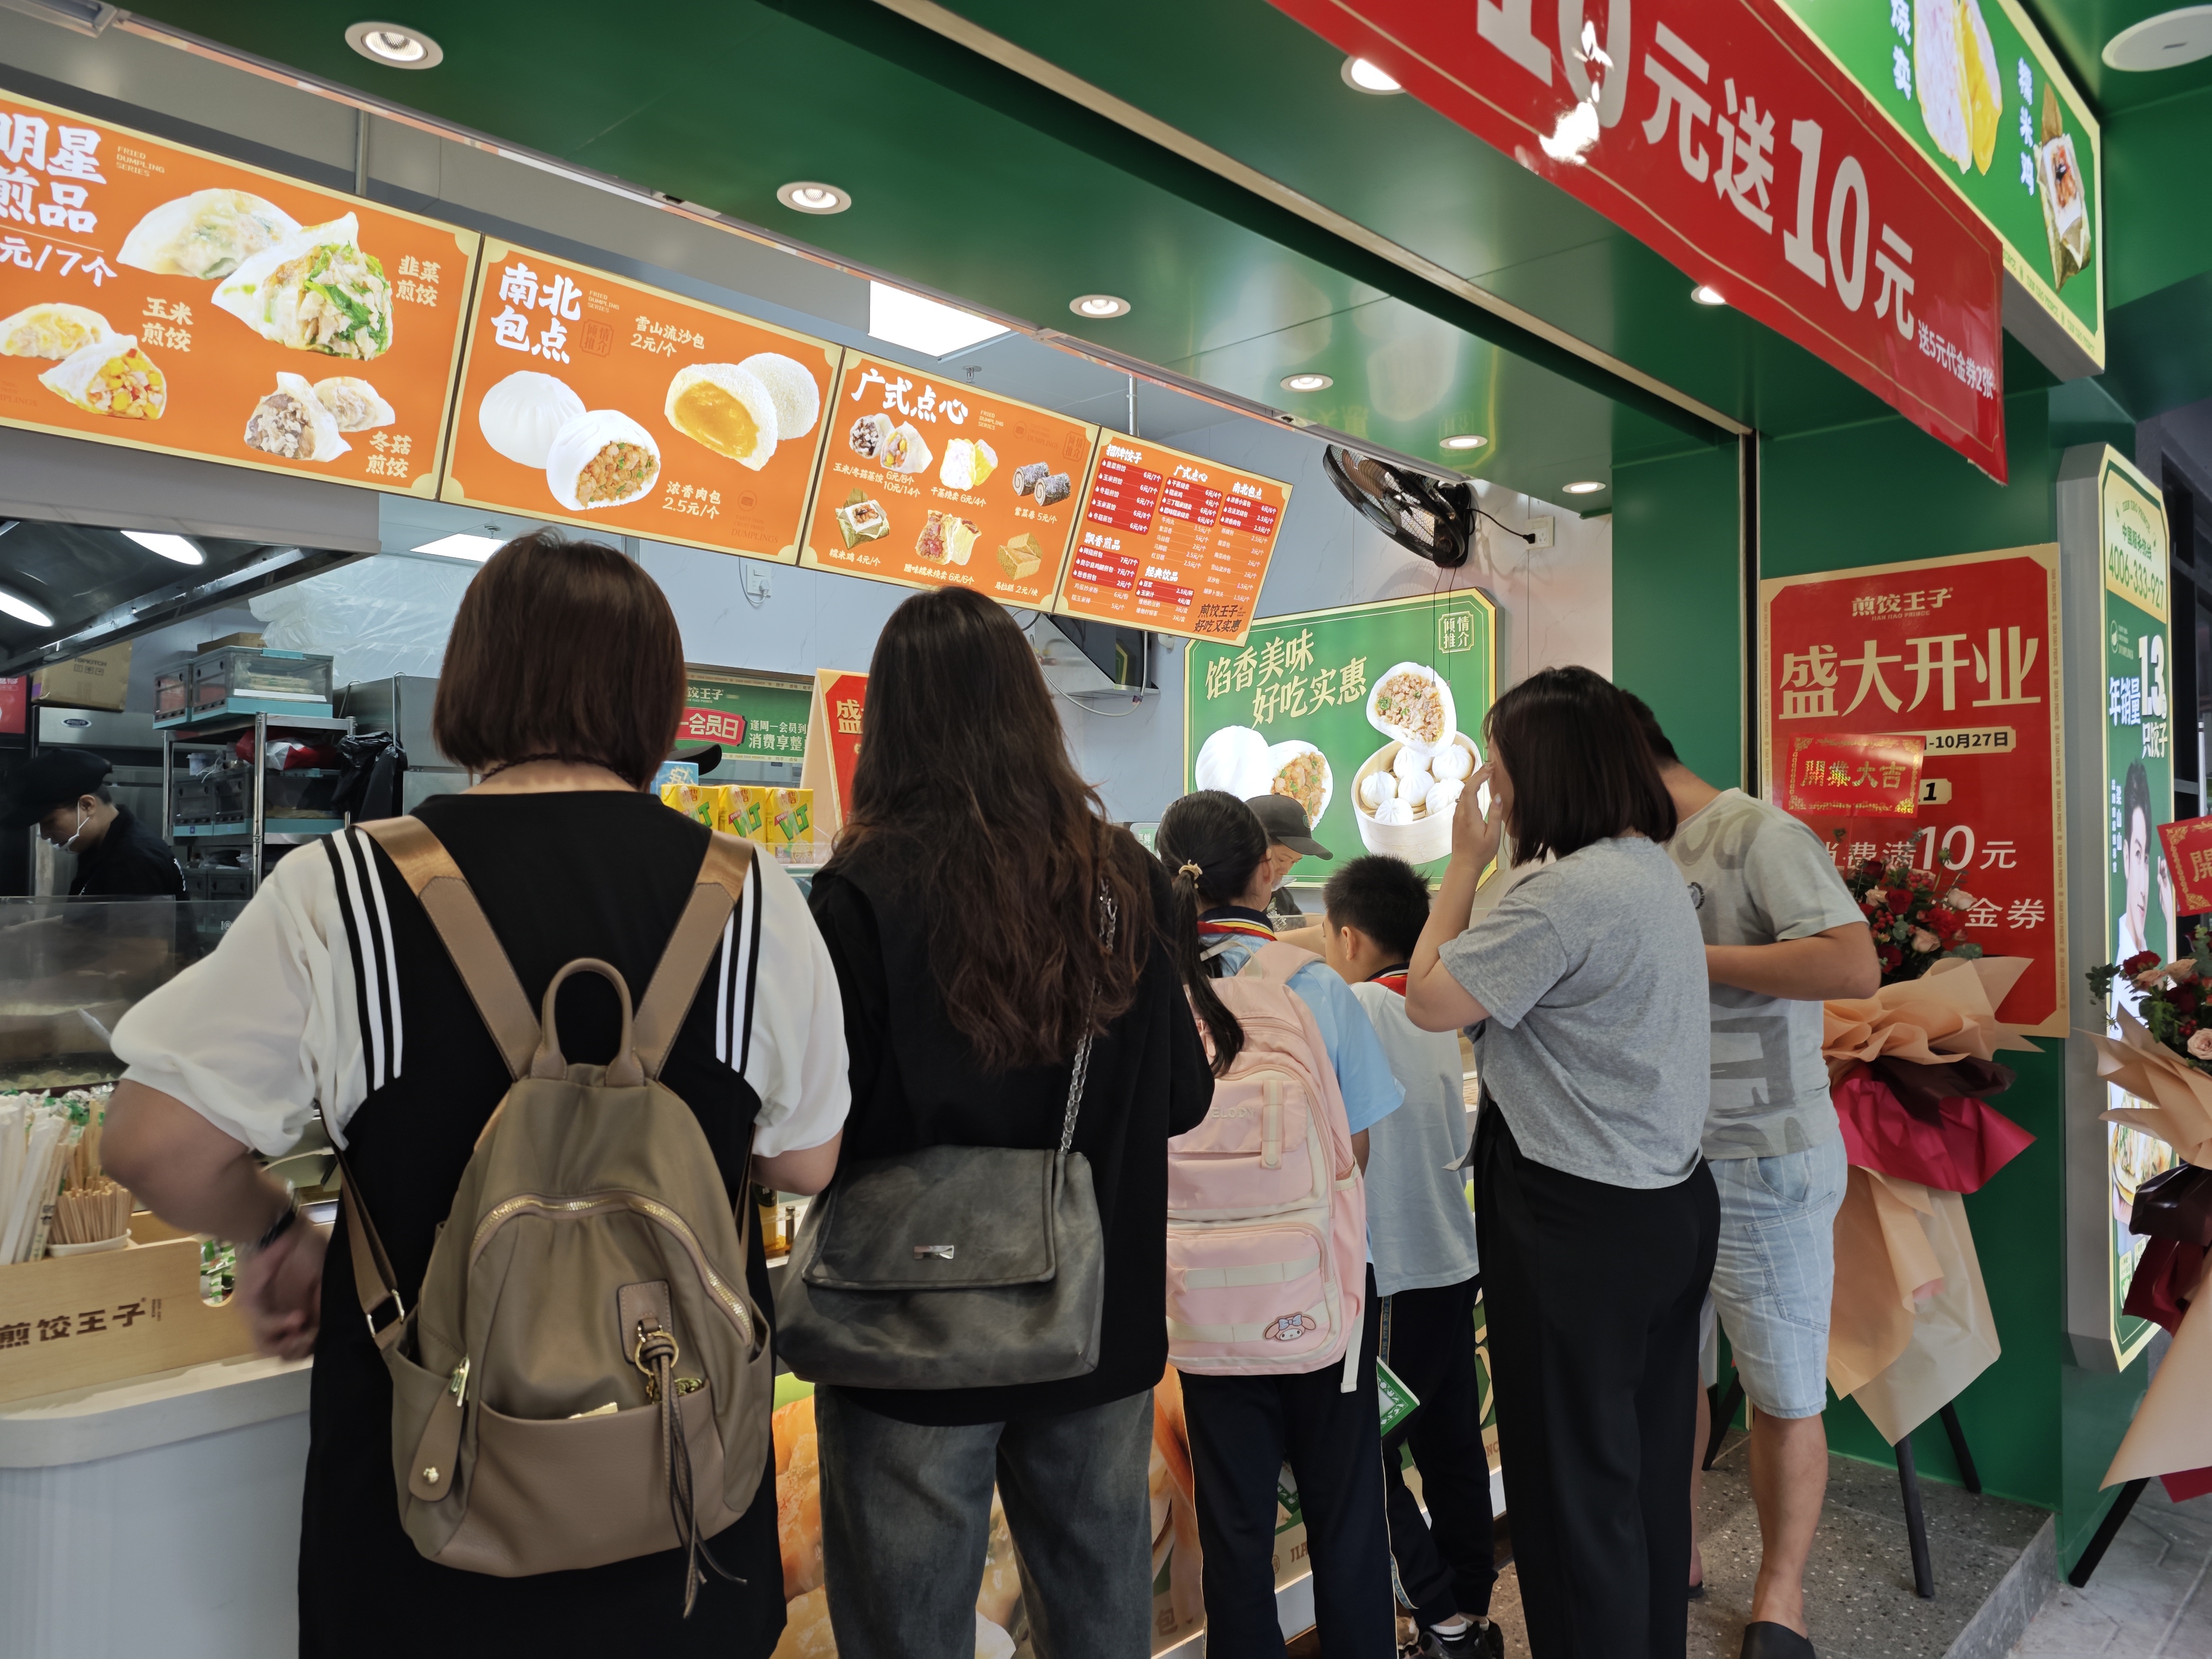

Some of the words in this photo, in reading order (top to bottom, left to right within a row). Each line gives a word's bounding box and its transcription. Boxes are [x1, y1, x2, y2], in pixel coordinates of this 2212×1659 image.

[0, 113, 107, 185] 明星
[117, 146, 146, 160] FRIED
[116, 154, 165, 174] DUMPLING
[116, 162, 150, 177] SERIES
[398, 255, 441, 284] 韭菜
[395, 279, 439, 307] 煎饺
[498, 262, 583, 321] 南北
[589, 290, 608, 300] FRIED
[142, 296, 194, 325] 玉米
[587, 302, 610, 313] SERIES
[588, 296, 619, 311] DUMPLING
[141, 322, 192, 352] 煎饺
[491, 305, 570, 364] 包点
[586, 322, 613, 341] 倾情
[635, 315, 705, 349] 雪山流沙包
[584, 336, 608, 353] 推介
[630, 333, 677, 358] 2元/个
[1918, 319, 1993, 400] 送5元代金券2张
[851, 368, 968, 425] 广式点心
[980, 410, 995, 419] FRIED
[978, 421, 996, 430] SERIES
[369, 430, 412, 455] 冬菇
[1106, 443, 1142, 464] 招牌饺子
[366, 454, 409, 478] 煎饺
[833, 462, 884, 484] 玉米/冬菇蒸饺
[886, 470, 914, 485] 6元/8个
[1173, 464, 1208, 482] 广式点心
[1143, 471, 1162, 482] 6元/7个
[666, 481, 721, 504] 浓香肉包
[884, 481, 921, 498] 10元/14个
[930, 487, 959, 502] 干蒸烧卖
[960, 494, 987, 508] 6元/4个
[1139, 484, 1158, 495] 6元/7个
[1205, 489, 1222, 500] 6元/4个
[1232, 481, 1263, 501] 南北包点
[662, 497, 720, 520] 2.5元/个
[1136, 497, 1155, 508] 6元/7个
[1205, 499, 1219, 508] 4元/个
[1260, 505, 1277, 515] 6元/6个
[1037, 512, 1057, 524] 5元/个
[1133, 510, 1151, 521] 6元/8个
[1197, 516, 1215, 527] 6元/6个
[1200, 507, 1217, 518] 6元/6个
[1256, 515, 1274, 525] 2.5元/个
[731, 528, 779, 544] DUMPLINGS
[1129, 522, 1148, 533] 6元/8个
[1253, 524, 1271, 535] 2.5元/个
[1192, 543, 1206, 552] 2元/个
[1195, 535, 1209, 543] 5元/个
[829, 548, 855, 562] 糯米鸡
[856, 555, 881, 567] 4元/个
[1120, 557, 1138, 567] 7元/7个
[1183, 559, 1202, 570] 2.5元/个
[903, 563, 948, 581] 腊味糯米烧卖
[948, 572, 975, 585] 6元/6个
[1117, 568, 1135, 578] 7元/7个
[1144, 565, 1178, 582] 经典饮品
[1244, 571, 1257, 579] 2元/个
[2108, 543, 2164, 610] 4006-333-927
[995, 581, 1015, 592] 马拉糕
[1015, 585, 1038, 597] 2元/块
[1116, 580, 1132, 589] 2元/个
[1111, 603, 1125, 611] 5元/个
[1198, 603, 1238, 618] 煎饺王子
[1851, 588, 1952, 617] 煎饺王子
[1192, 619, 1242, 633] 好吃又实惠
[1443, 616, 1469, 634] 倾情
[1443, 631, 1469, 649] 推介
[1204, 628, 1315, 700] 馅香美味
[1778, 625, 2041, 720] 盛大开业
[1251, 656, 1367, 730] 好吃实惠
[2109, 676, 2141, 726] 年销量
[837, 699, 865, 734] 盛
[750, 719, 808, 734] 逢周一会员到
[748, 733, 807, 751] 消费享整
[1924, 732, 2008, 750] -10月27日
[2142, 722, 2168, 759] 只饺子
[0, 1303, 145, 1350] 煎饺王子
